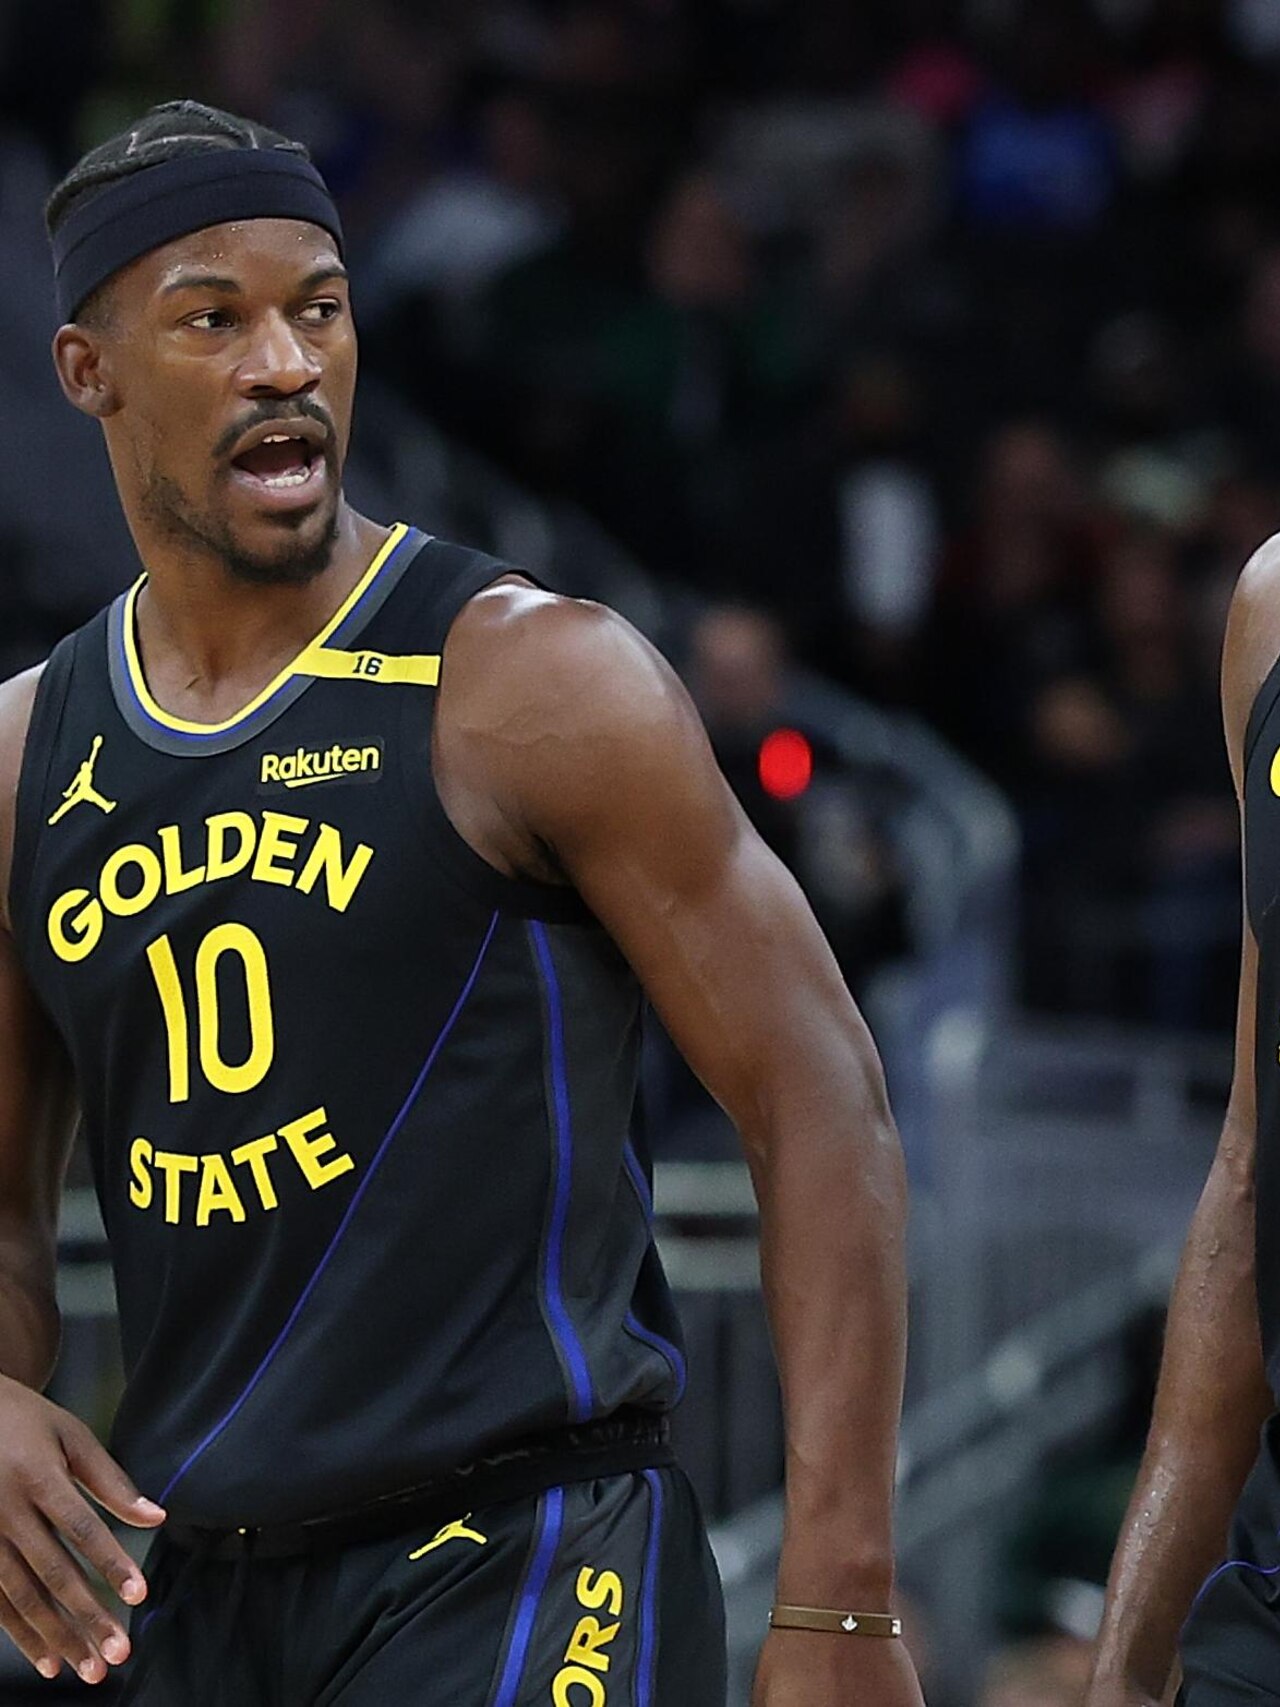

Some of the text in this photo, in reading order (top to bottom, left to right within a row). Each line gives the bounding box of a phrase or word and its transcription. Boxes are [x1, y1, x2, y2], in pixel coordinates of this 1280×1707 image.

[352, 654, 384, 676] 16
[260, 744, 380, 788] Rakuten
[47, 811, 374, 963] GOLDEN
[146, 921, 275, 1103] 10
[129, 1106, 355, 1226] STATE
